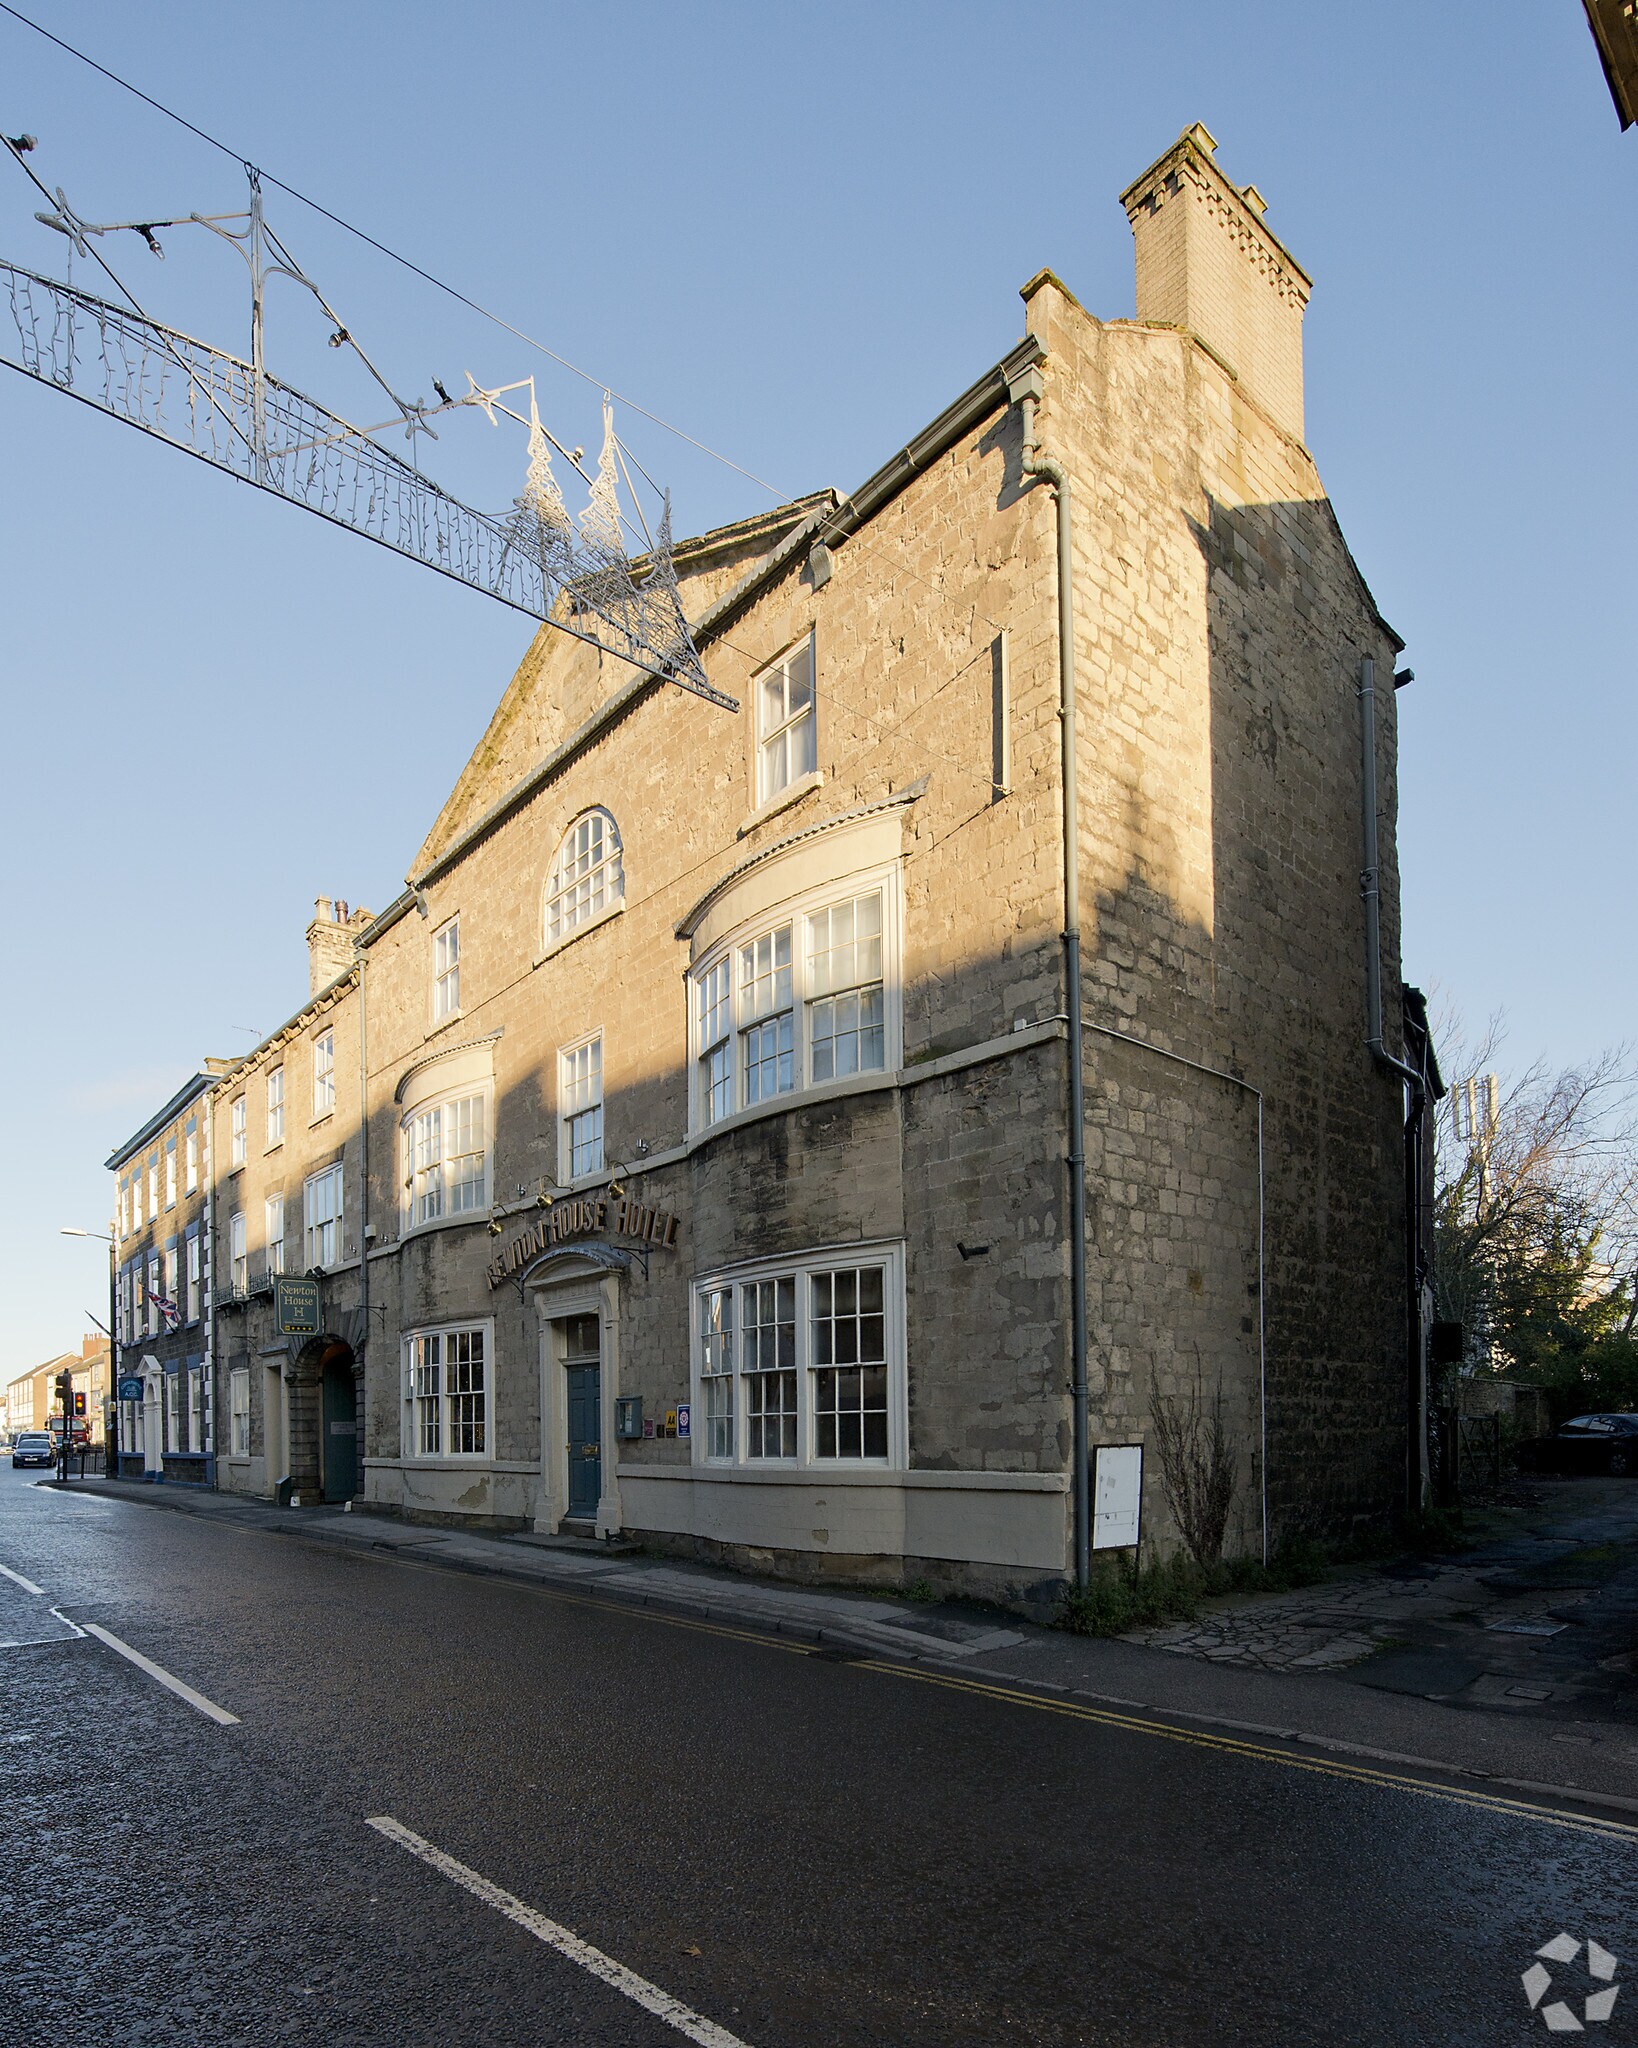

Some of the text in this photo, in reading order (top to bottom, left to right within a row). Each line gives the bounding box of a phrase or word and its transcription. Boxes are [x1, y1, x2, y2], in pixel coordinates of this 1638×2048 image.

[485, 1198, 677, 1291] NEWTON HOUSE HOTEL
[280, 1285, 316, 1296] Newton
[284, 1295, 314, 1306] House
